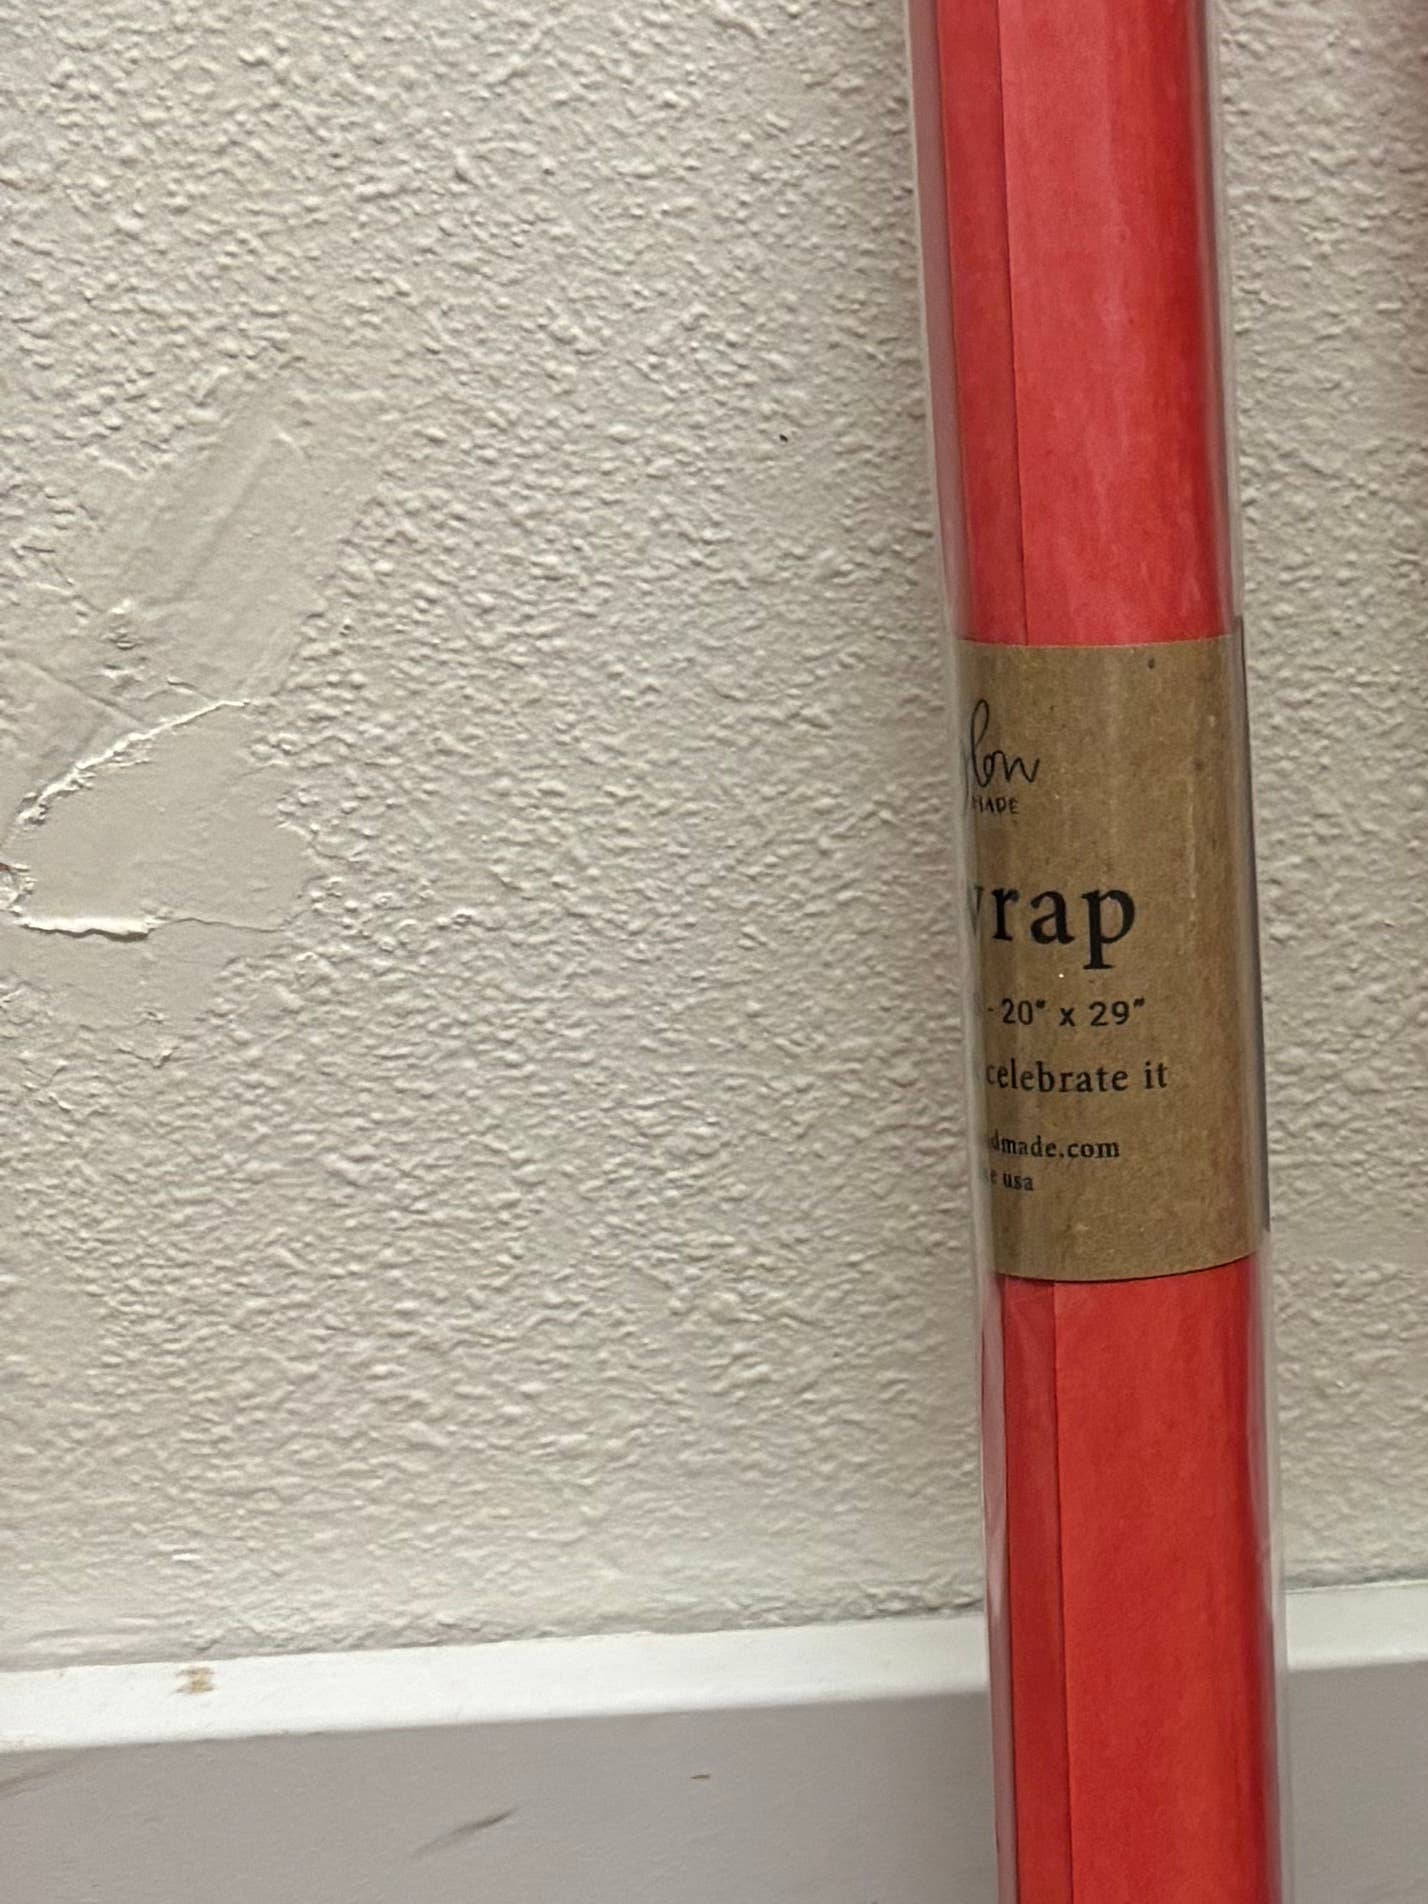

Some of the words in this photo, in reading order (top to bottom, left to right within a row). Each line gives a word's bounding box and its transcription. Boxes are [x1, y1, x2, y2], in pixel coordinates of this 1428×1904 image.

[964, 699, 1040, 788] low
[1059, 1007, 1076, 1027] x
[986, 1057, 1129, 1093] celebrate
[1144, 1061, 1169, 1090] it
[990, 1129, 1121, 1159] dmade.com
[1002, 1171, 1035, 1192] usa
